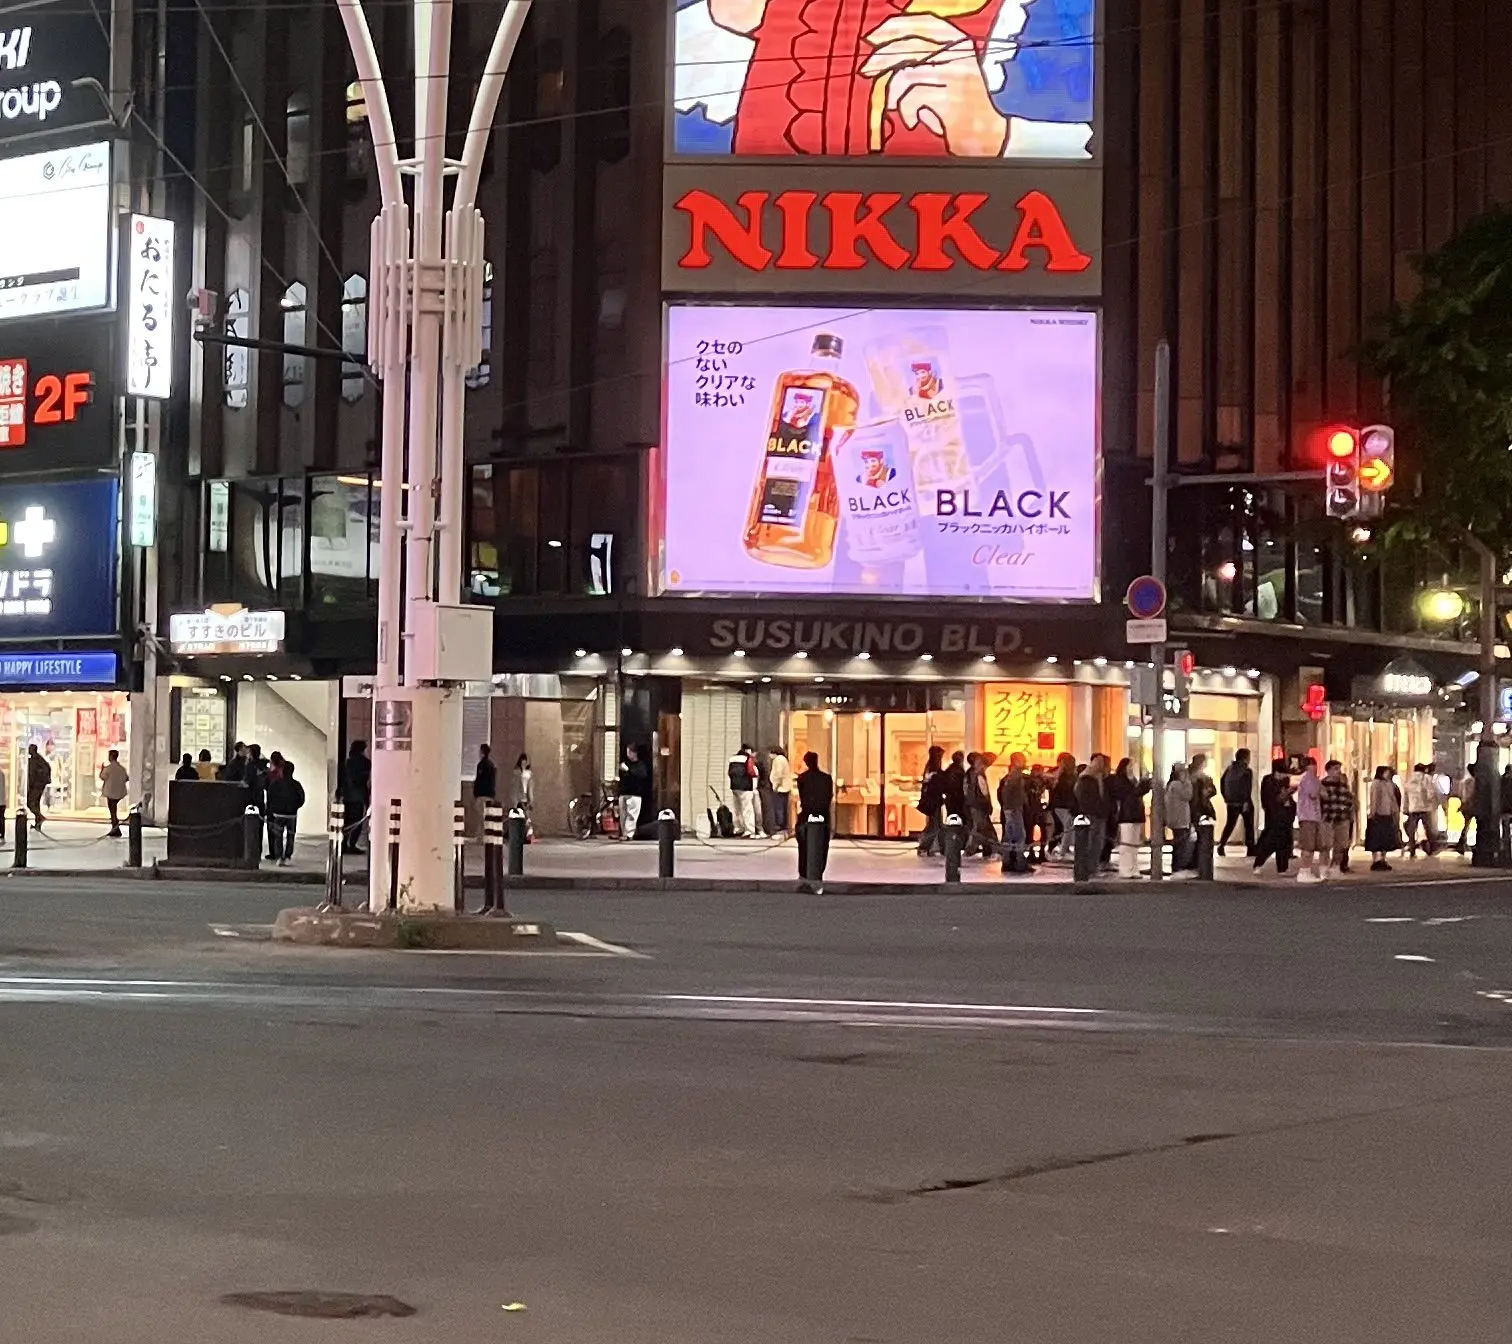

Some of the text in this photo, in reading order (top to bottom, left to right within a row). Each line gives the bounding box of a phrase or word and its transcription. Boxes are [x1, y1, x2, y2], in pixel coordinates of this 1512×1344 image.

[673, 189, 1092, 273] NIKKA
[695, 339, 743, 355] クセの
[695, 358, 727, 372] ない
[695, 374, 757, 390] クリアな
[34, 372, 91, 424] 2F
[695, 392, 745, 407] 味わい
[904, 399, 955, 422] BLACK
[767, 438, 822, 457] BLACK
[849, 488, 912, 513] BLACK
[936, 489, 1072, 519] BLACK
[938, 522, 1071, 535] ブラックニッカハイボール
[972, 544, 1036, 566] Clear
[188, 622, 267, 639] すすきのビル
[709, 619, 1034, 654] SUSUKINO BLD.
[4, 659, 33, 676] HAPPY
[35, 658, 83, 675] LIFESTYLE
[993, 690, 1013, 756] スクエア
[1014, 691, 1035, 756] タイムズ
